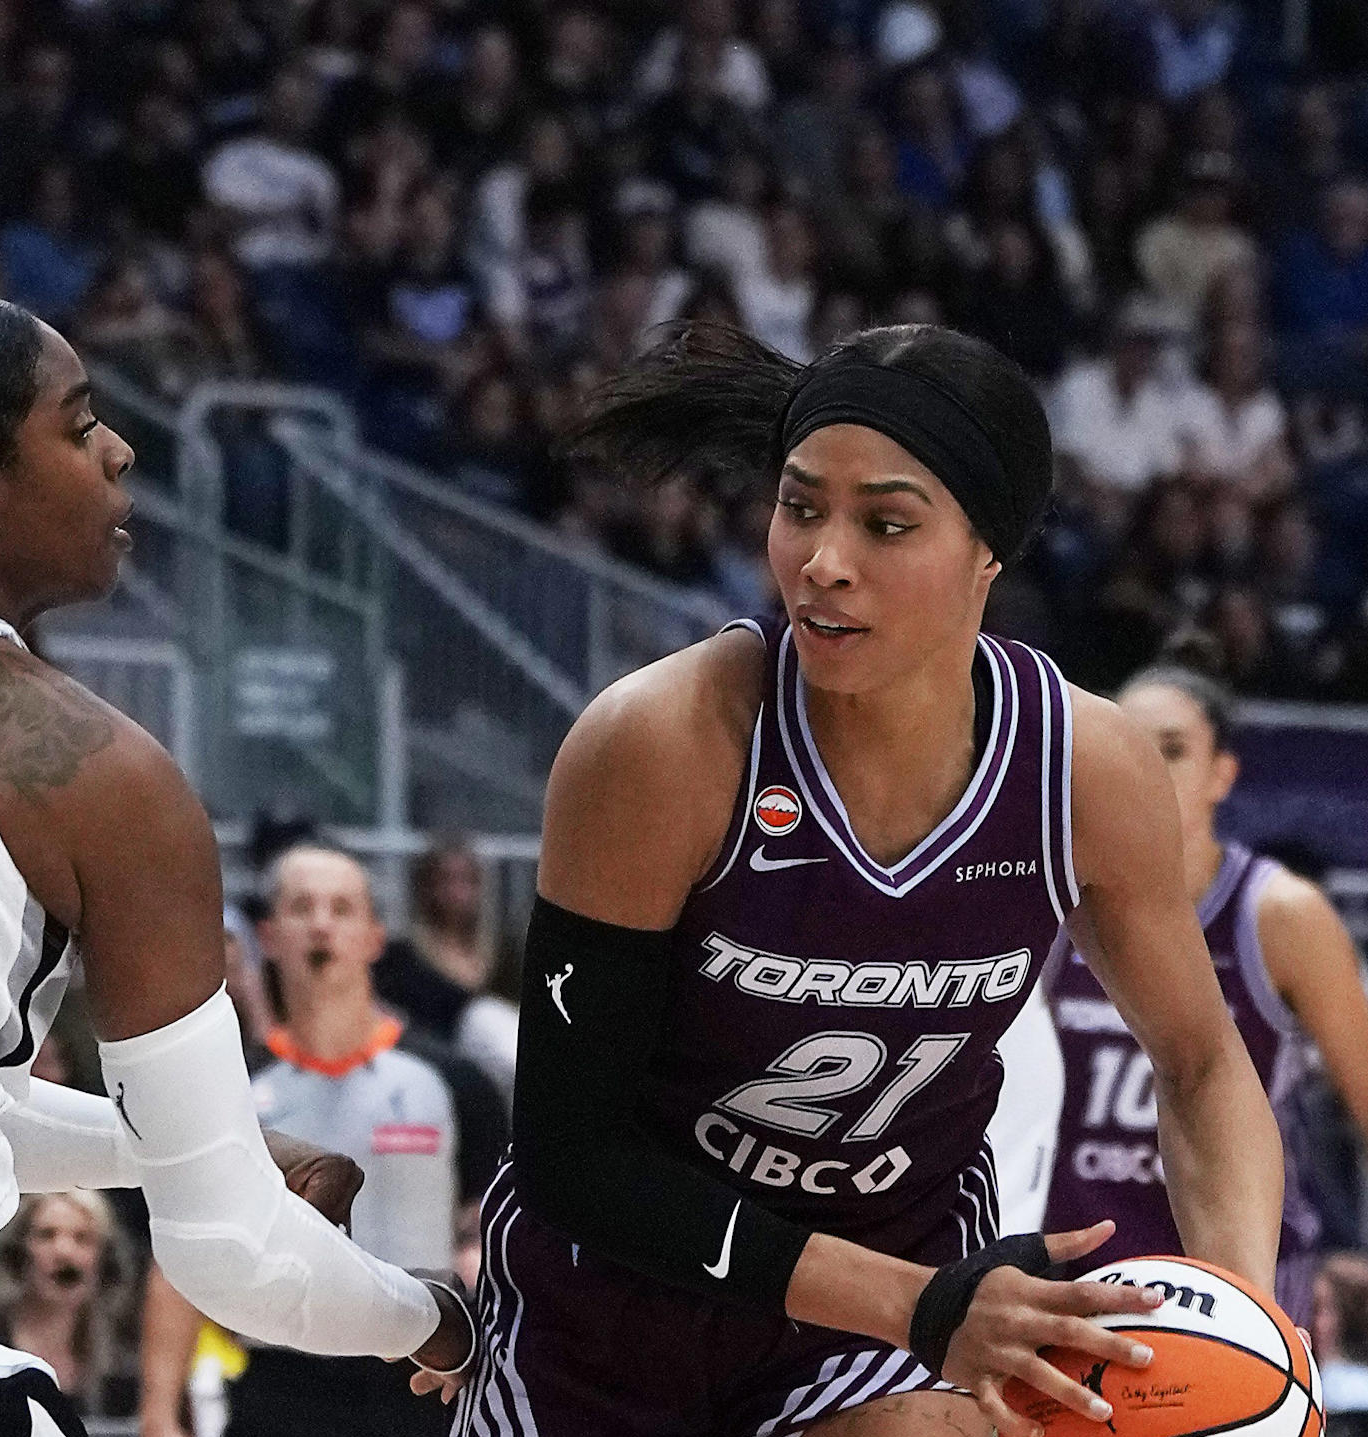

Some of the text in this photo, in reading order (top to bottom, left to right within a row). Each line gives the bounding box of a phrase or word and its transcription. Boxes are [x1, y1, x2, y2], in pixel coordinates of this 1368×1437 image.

[955, 859, 1037, 883] SEPHORA
[698, 931, 1032, 1009] TORONTO
[711, 1030, 972, 1144] 21
